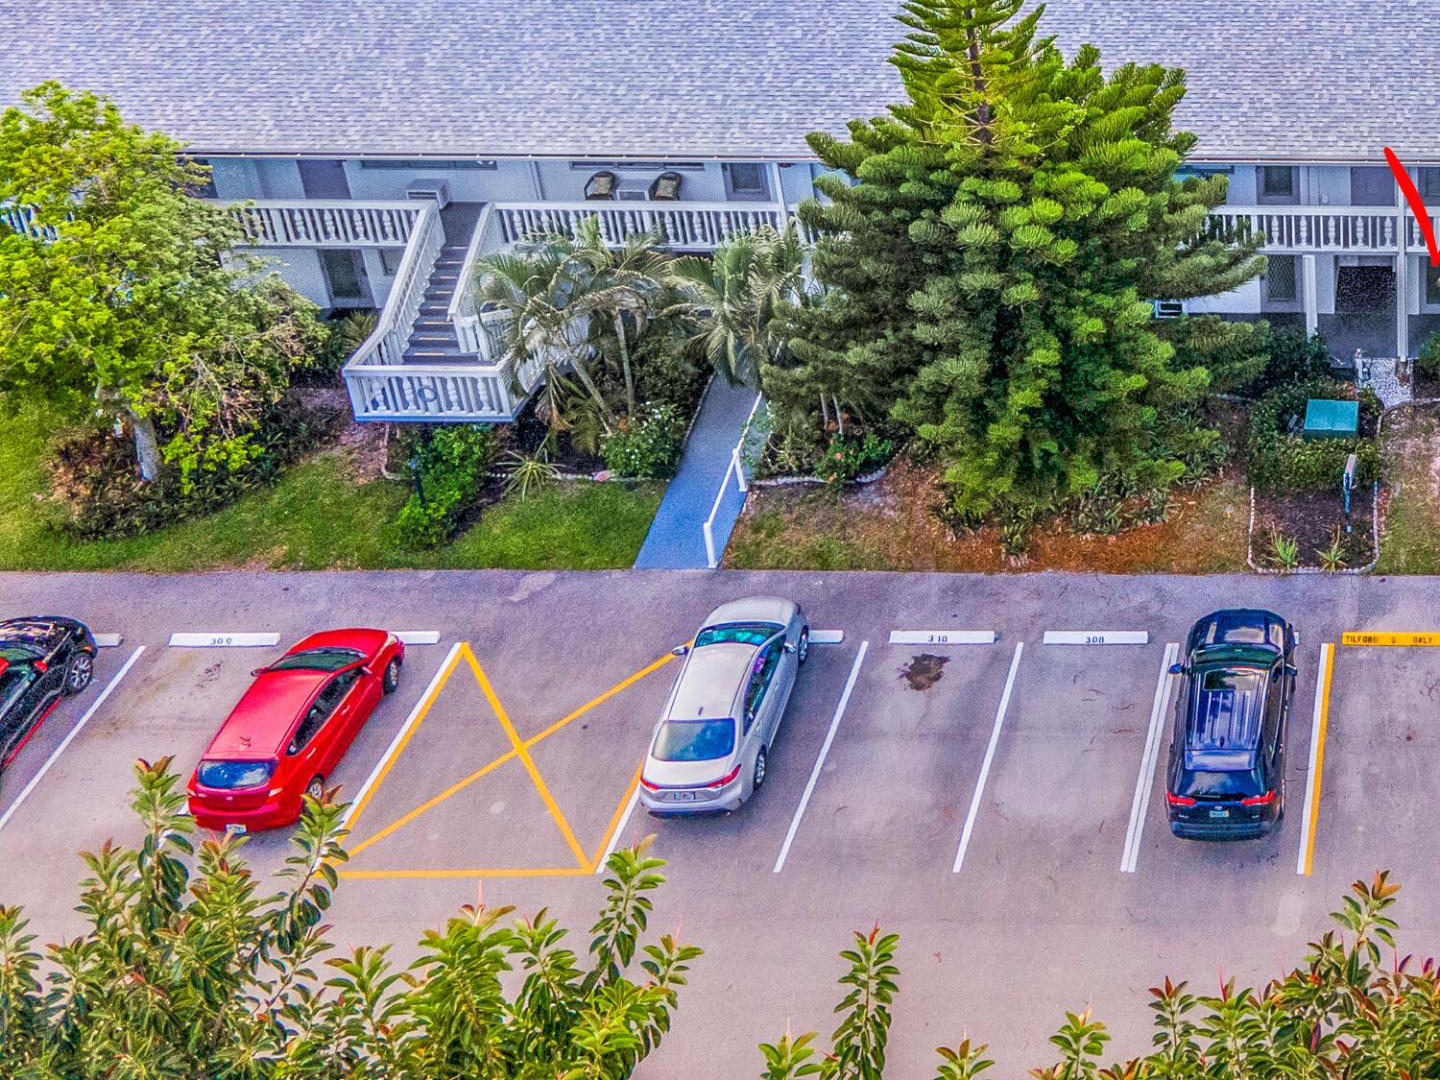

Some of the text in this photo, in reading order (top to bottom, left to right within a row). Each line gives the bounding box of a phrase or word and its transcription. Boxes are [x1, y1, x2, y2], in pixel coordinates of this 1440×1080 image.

[928, 635, 948, 643] 310
[1346, 635, 1378, 643] TILFORD
[1413, 636, 1433, 644] ONLY
